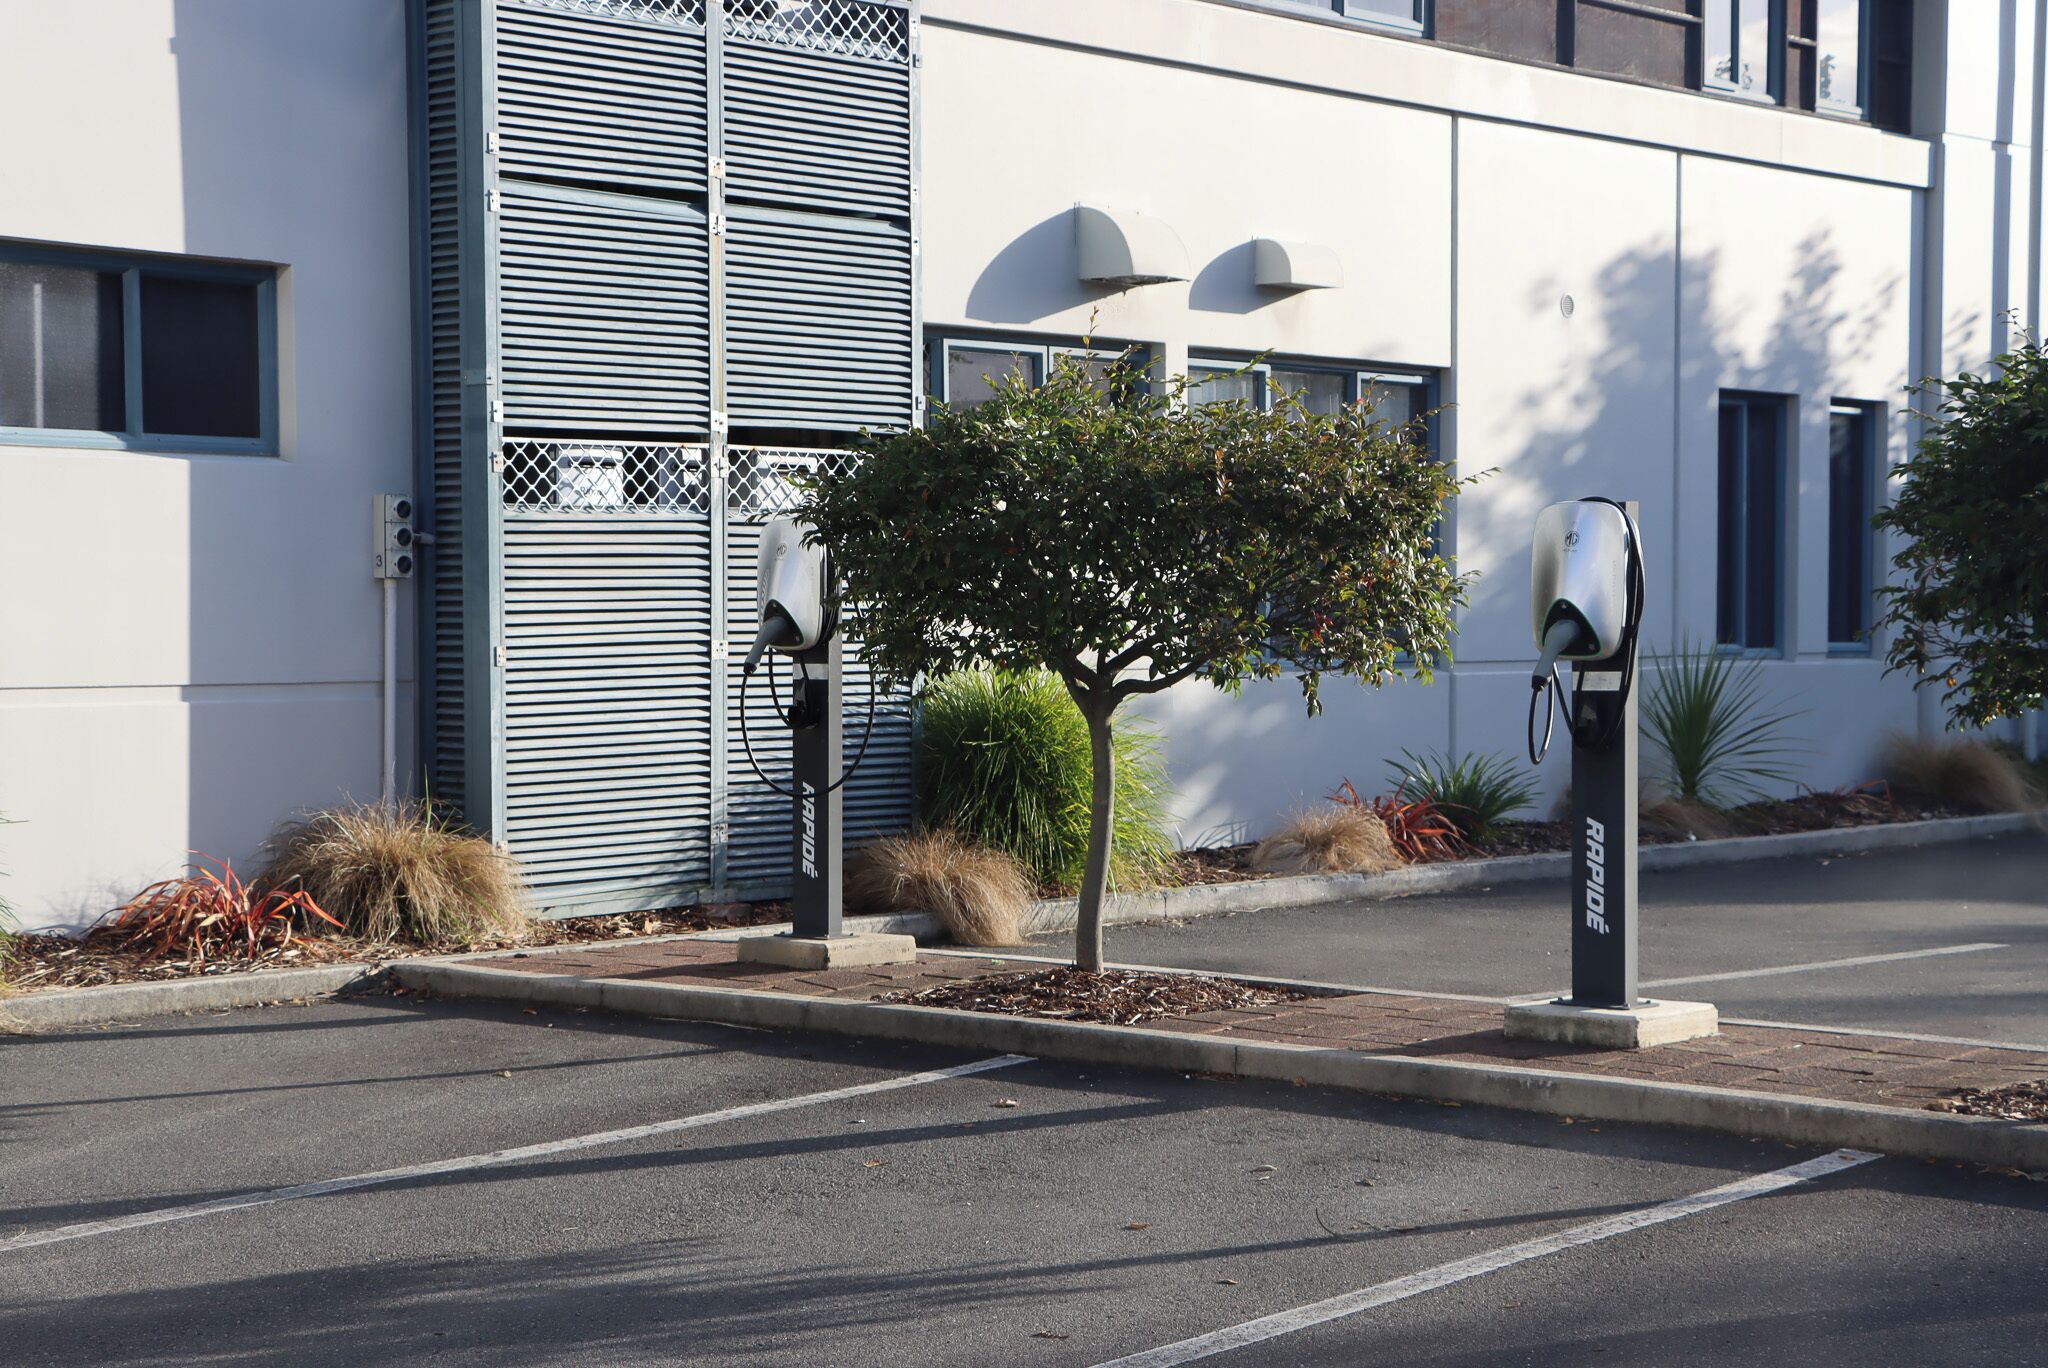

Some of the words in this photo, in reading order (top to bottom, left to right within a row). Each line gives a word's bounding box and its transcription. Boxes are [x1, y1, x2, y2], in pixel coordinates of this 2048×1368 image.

[1565, 531, 1579, 546] MG
[376, 554, 383, 568] 3
[1586, 816, 1610, 935] RAPIDÉ
